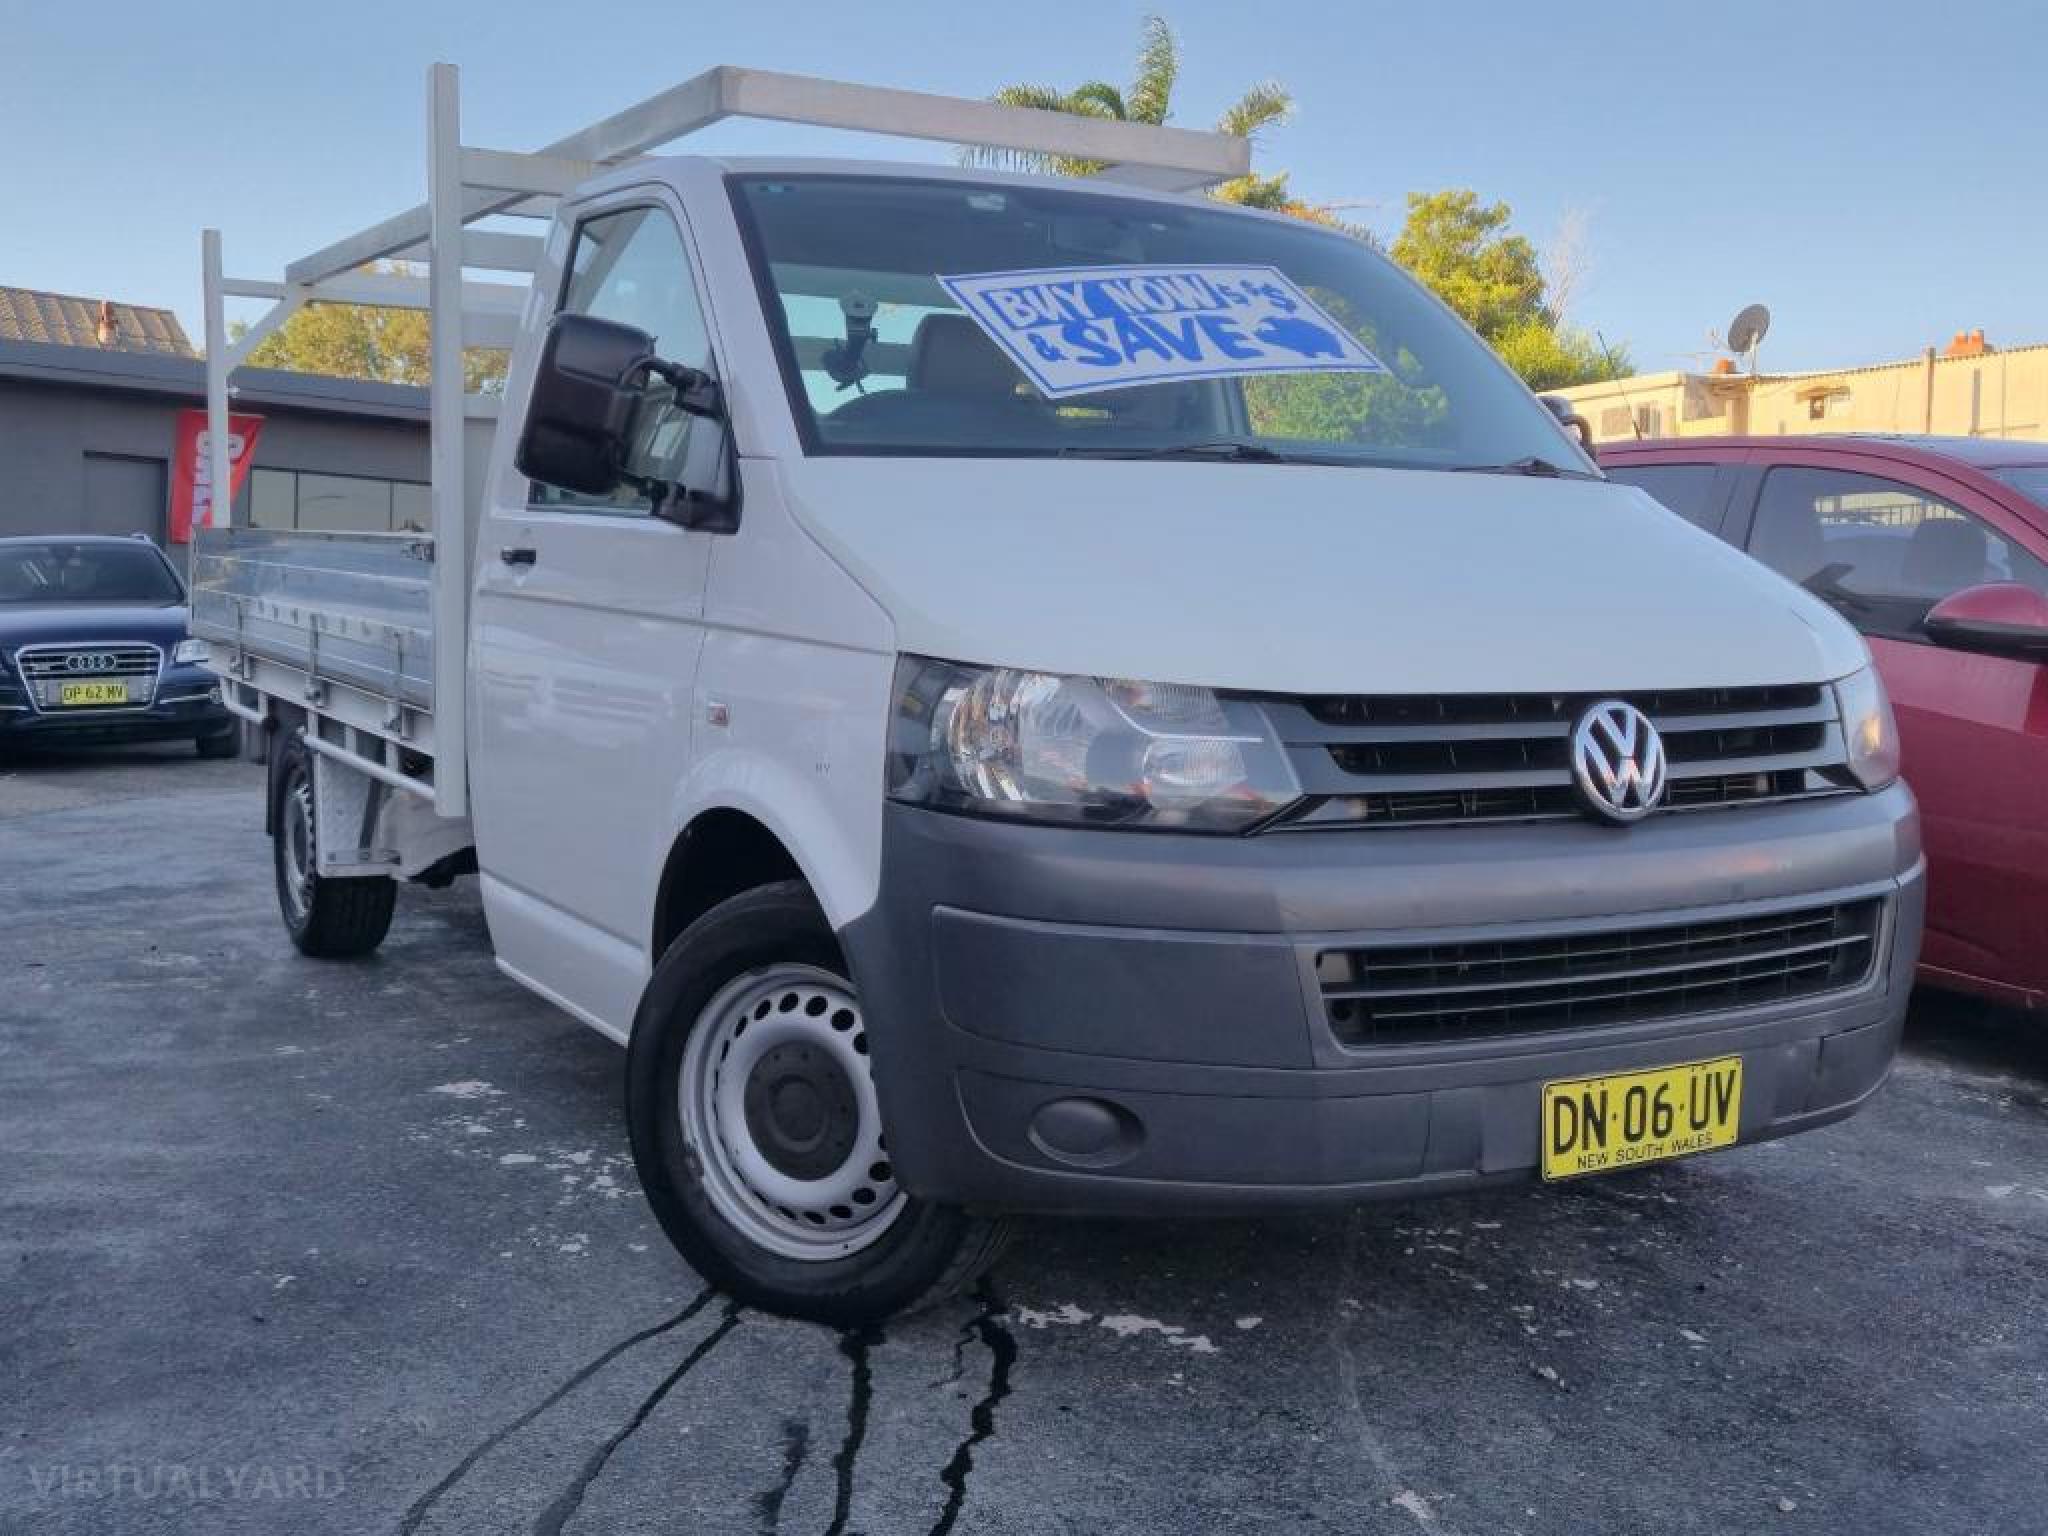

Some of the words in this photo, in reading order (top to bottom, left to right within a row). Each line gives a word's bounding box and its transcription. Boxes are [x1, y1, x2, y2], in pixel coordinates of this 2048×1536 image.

[999, 279, 1094, 327] BUY
[1101, 273, 1210, 314] NOW
[1027, 333, 1068, 362] &
[1063, 314, 1265, 367] SAVE
[1577, 1152, 1609, 1169] NEW
[1615, 1143, 1665, 1163] SOUTH
[1671, 1131, 1714, 1153] WALES
